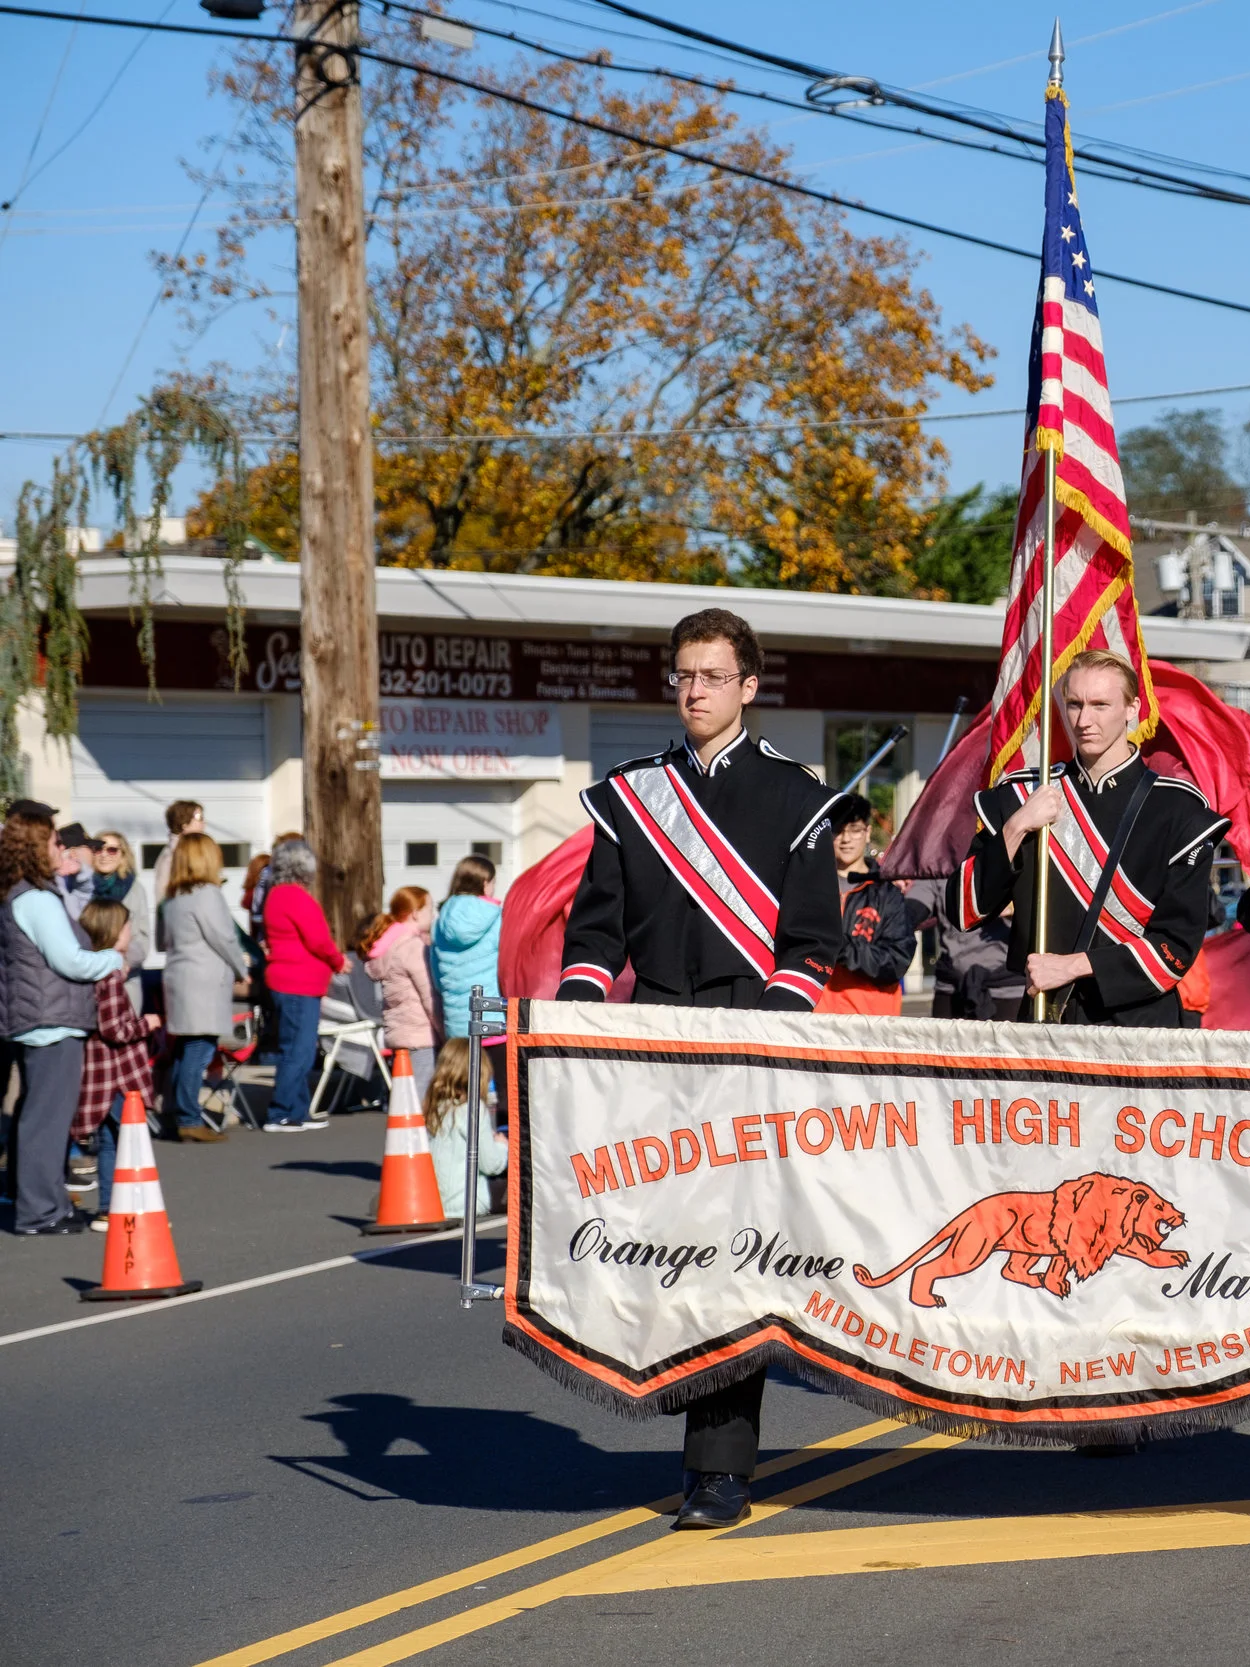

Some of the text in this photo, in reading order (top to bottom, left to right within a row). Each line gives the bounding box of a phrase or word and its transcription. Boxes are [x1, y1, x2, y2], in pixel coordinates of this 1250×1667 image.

[380, 635, 512, 670] UTO REPAIR
[380, 668, 512, 697] 32-201-0073
[379, 706, 550, 737] TO REPAIR SHOP
[390, 744, 446, 775] NOW
[570, 1101, 918, 1198] MIDDLETOWN
[952, 1098, 1081, 1147] HIGH
[123, 1215, 136, 1275] MTAP
[569, 1217, 718, 1289] Orange
[730, 1227, 845, 1280] Wave
[804, 1291, 1037, 1392] MIDDLETOWN,
[1060, 1351, 1136, 1385] NEW
